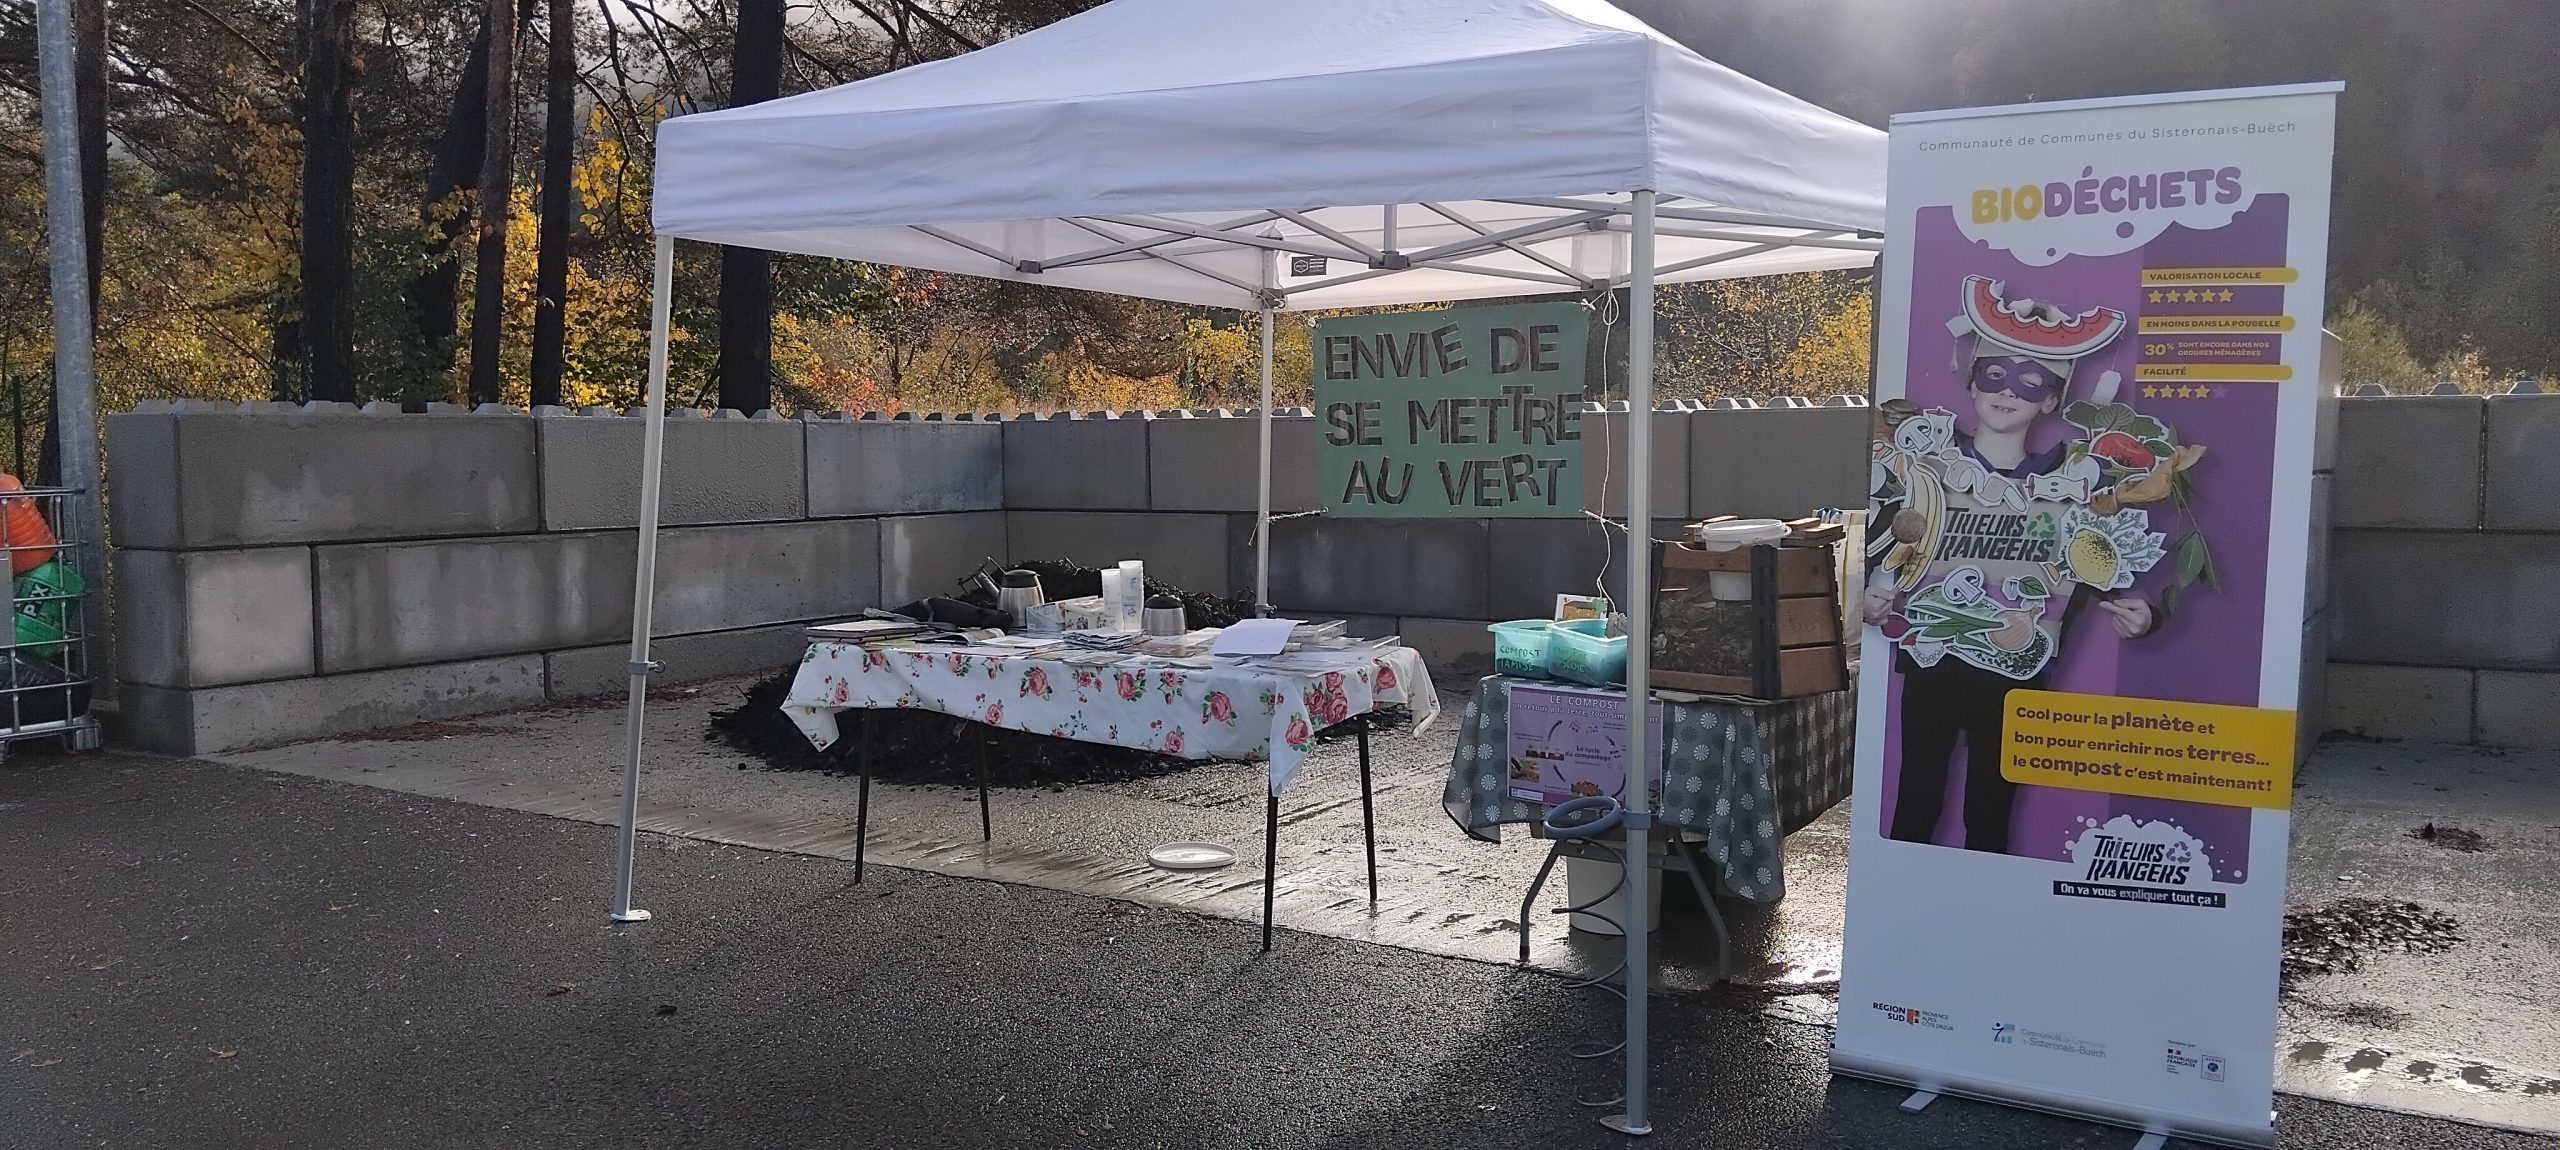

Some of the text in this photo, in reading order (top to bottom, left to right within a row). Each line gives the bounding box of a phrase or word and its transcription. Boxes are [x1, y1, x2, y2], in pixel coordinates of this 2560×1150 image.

[1919, 121, 2296, 151] Communauté de Communes du Sisteronais-Buëch
[1971, 165, 2242, 224] BIODÉCHETS
[2150, 271, 2261, 280] VALORISATION LOCALE
[1325, 321, 1560, 380] ENVIE DE
[2144, 343, 2175, 356] 30%
[2214, 348, 2262, 356] MÉNAGÈRES
[2143, 366, 2187, 376] FACILITÉ
[1325, 384, 1582, 447] SE METTRE
[1342, 453, 1567, 507] AU VERT
[1934, 535, 2055, 562] RANGERS
[1500, 645, 1541, 658] COMPOST
[1524, 703, 1547, 712] retour
[1550, 695, 1619, 710] LE COMPOST
[2016, 707, 2216, 734] Cool pour la planète et
[2014, 731, 2270, 767] bon pour enrichir nos terres...
[2013, 755, 2027, 767] le
[2029, 756, 2122, 777] compost
[2124, 767, 2164, 782] c'est
[2086, 858, 2190, 885] RANGERS
[2061, 883, 2075, 894] On
[2077, 885, 2089, 896] va
[2092, 887, 2117, 898] vous
[2119, 889, 2169, 902] expliquer
[2171, 892, 2195, 904] tout
[2197, 895, 2211, 907] ça
[1887, 1012, 1906, 1022] SUD
